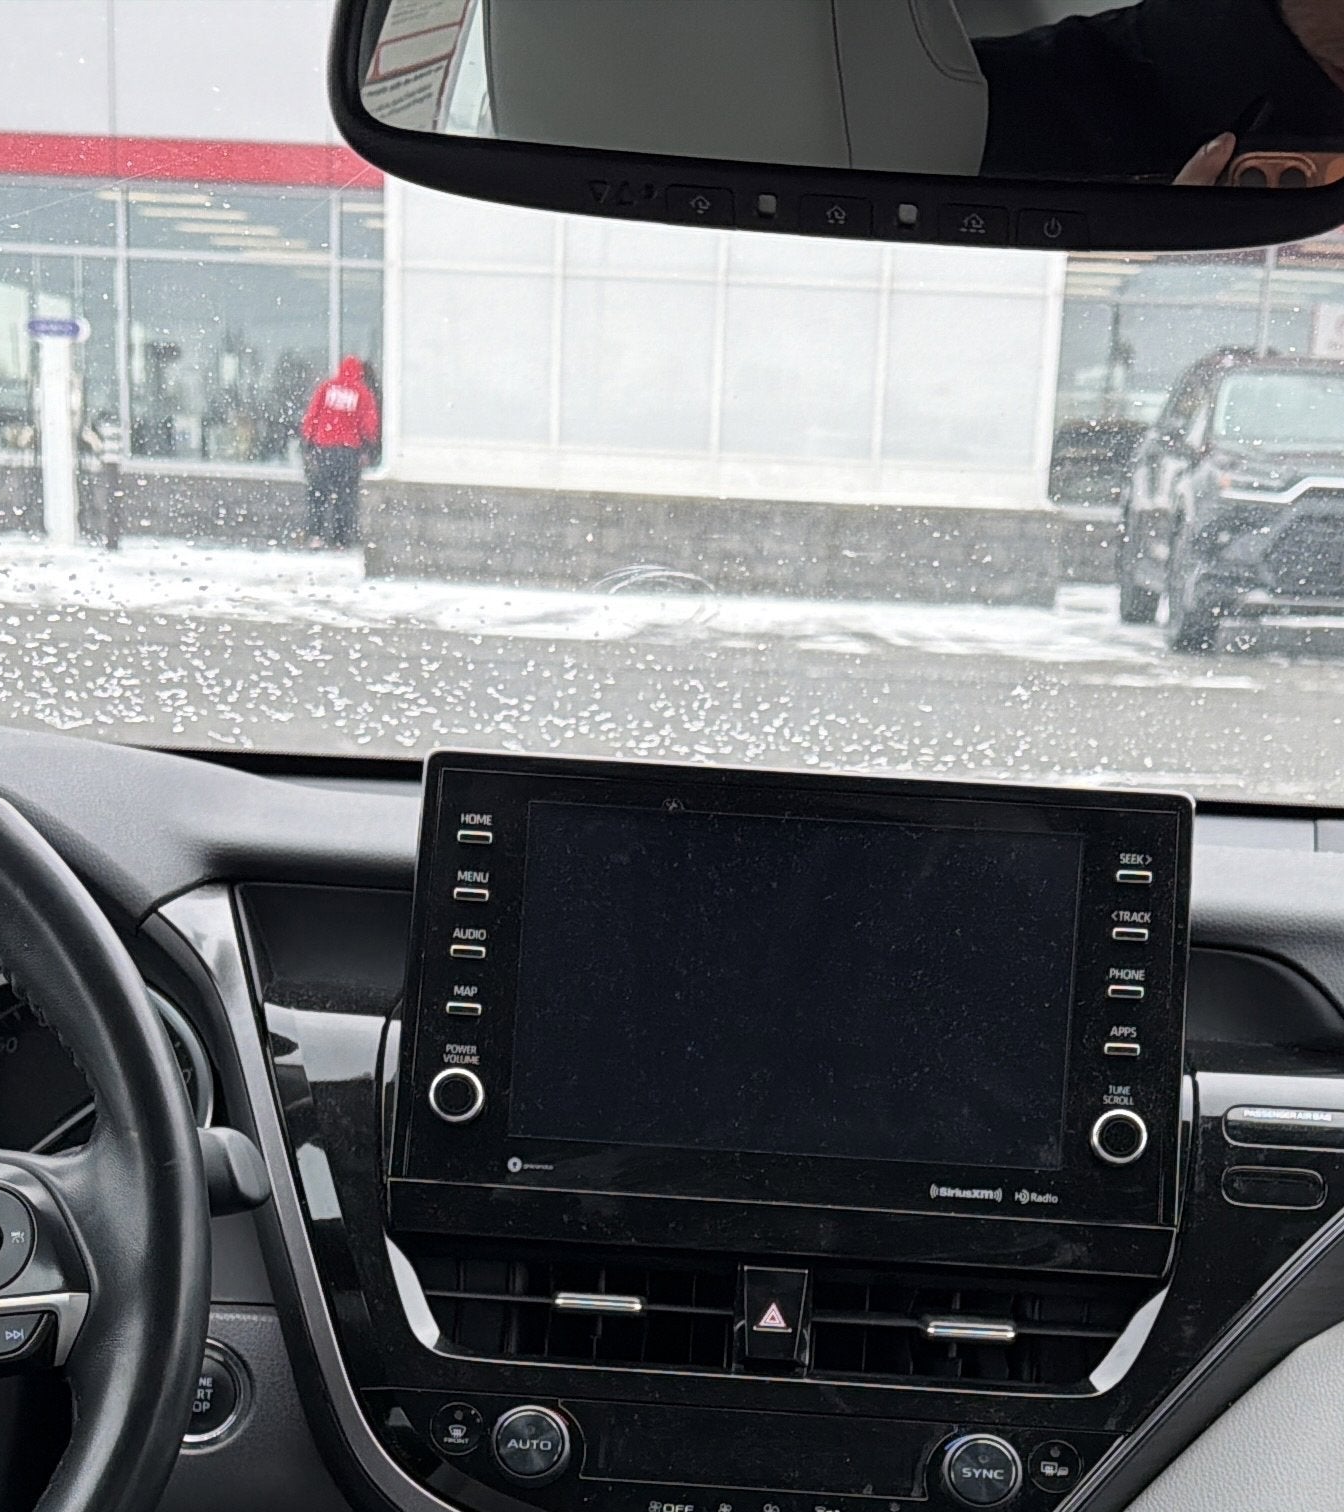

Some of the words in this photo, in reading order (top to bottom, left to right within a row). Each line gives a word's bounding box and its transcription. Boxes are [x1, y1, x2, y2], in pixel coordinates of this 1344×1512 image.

[460, 813, 493, 826] HOME
[1119, 853, 1144, 865] SEEK
[457, 869, 490, 883] MENU
[1118, 910, 1152, 923] TRACK
[452, 927, 487, 941] AUDIO
[1108, 967, 1146, 981] PHONE
[453, 985, 478, 997] MAP
[1109, 1026, 1138, 1038] APPS
[445, 1043, 477, 1055] POWER
[442, 1053, 480, 1066] VOLUME
[1108, 1084, 1131, 1096] TUNE
[1102, 1095, 1134, 1106] SCROLL
[1030, 1193, 1059, 1204] Radio
[507, 1438, 552, 1451] AUTO
[962, 1467, 1005, 1480] SYNC
